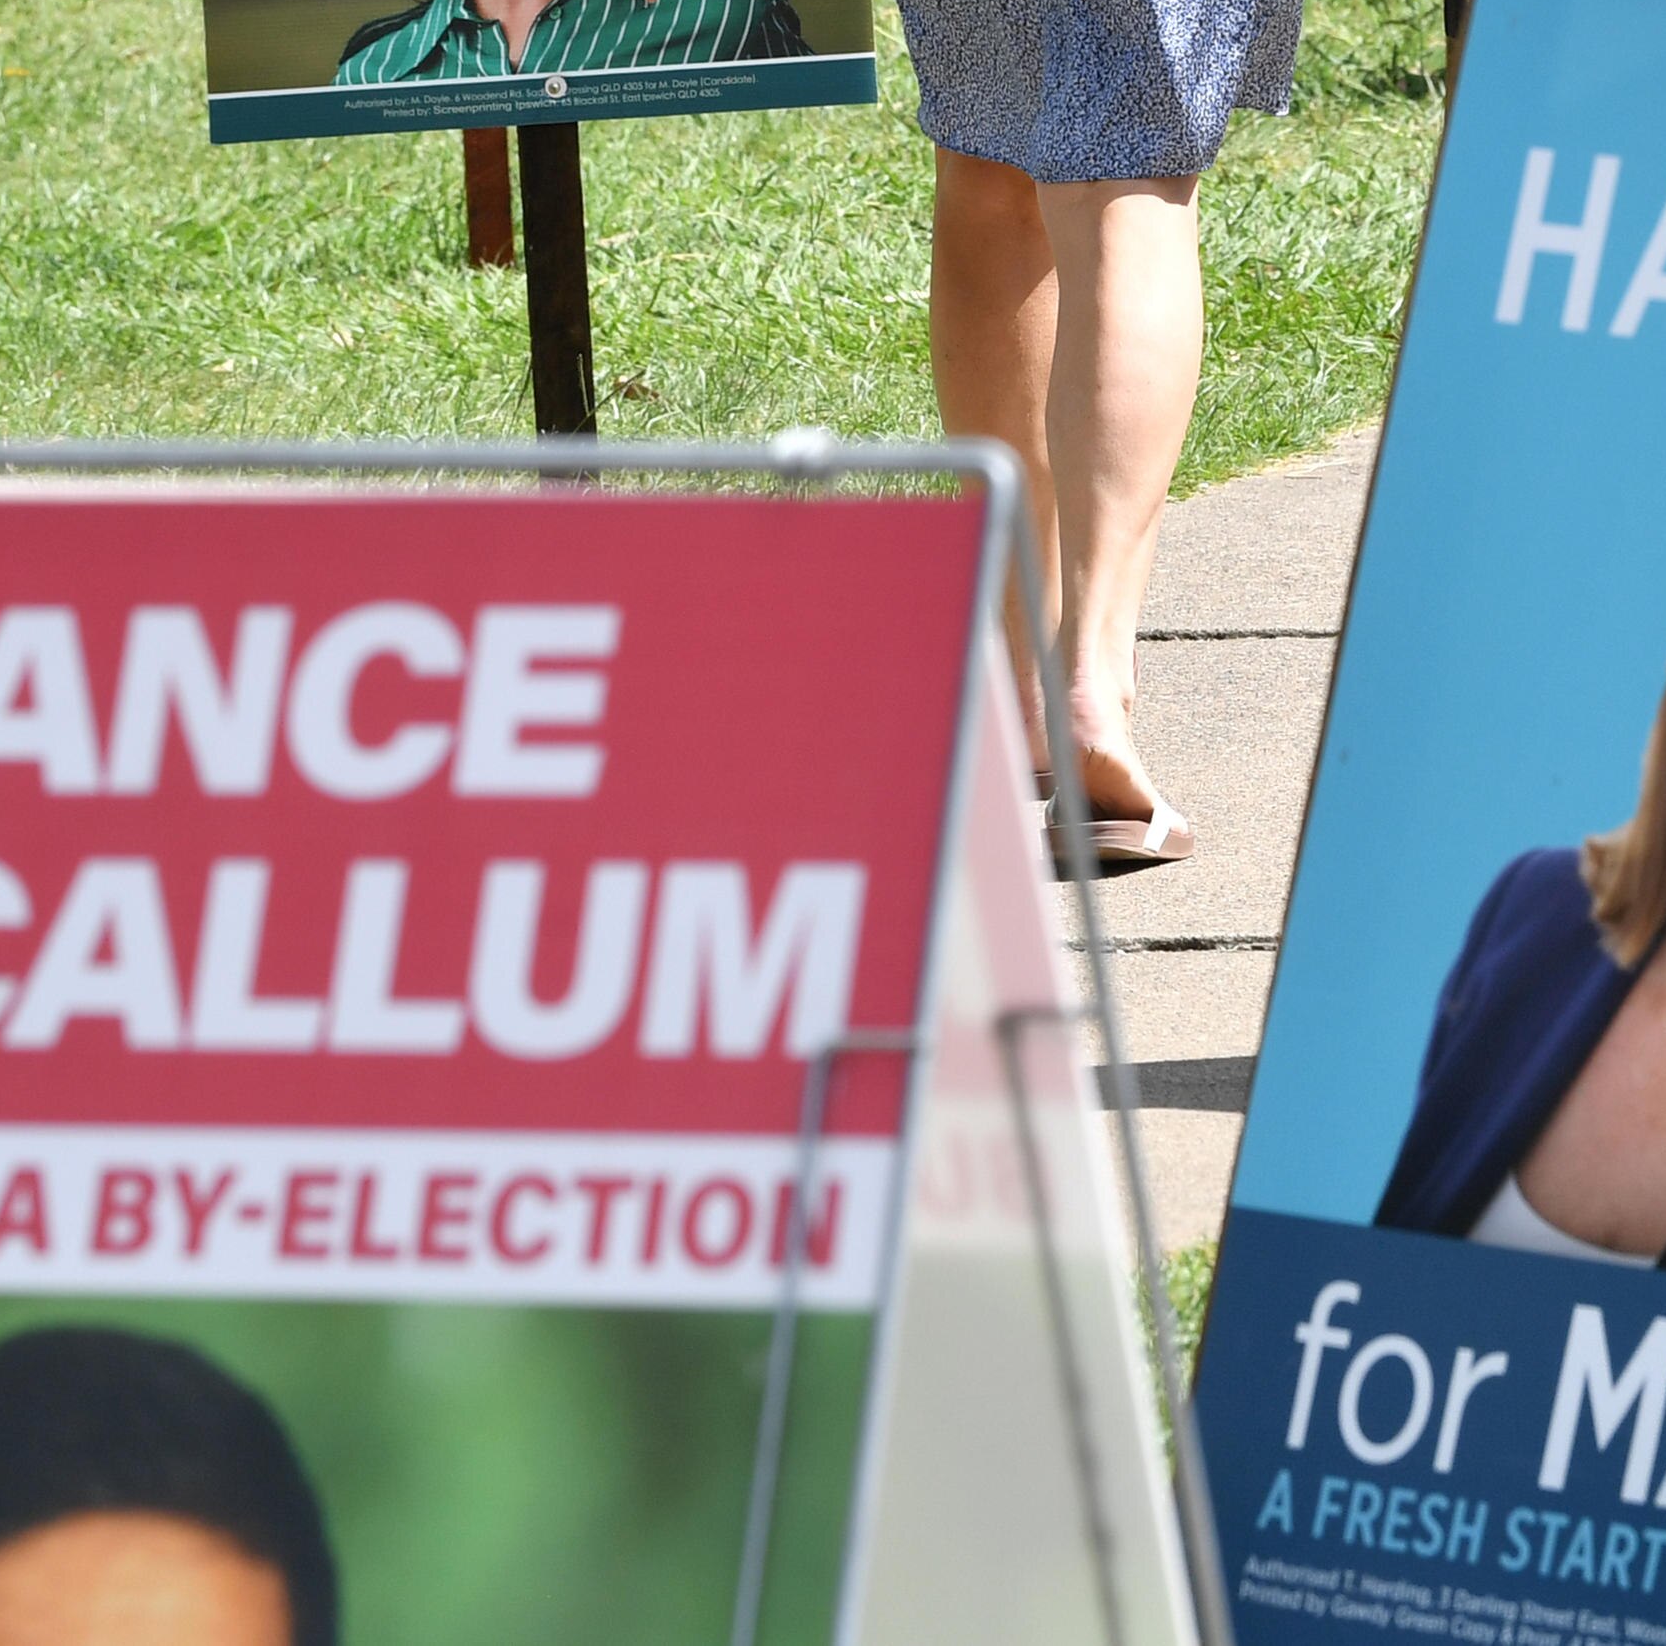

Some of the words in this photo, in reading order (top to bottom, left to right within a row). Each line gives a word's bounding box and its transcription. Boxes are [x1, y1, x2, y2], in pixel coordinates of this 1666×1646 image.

[433, 101, 512, 115] Screenprinting
[86, 1167, 845, 1273] BY-ELECTION
[1285, 1280, 1509, 1474] for
[1256, 1468, 1294, 1534] A
[1311, 1476, 1489, 1565] FRESH
